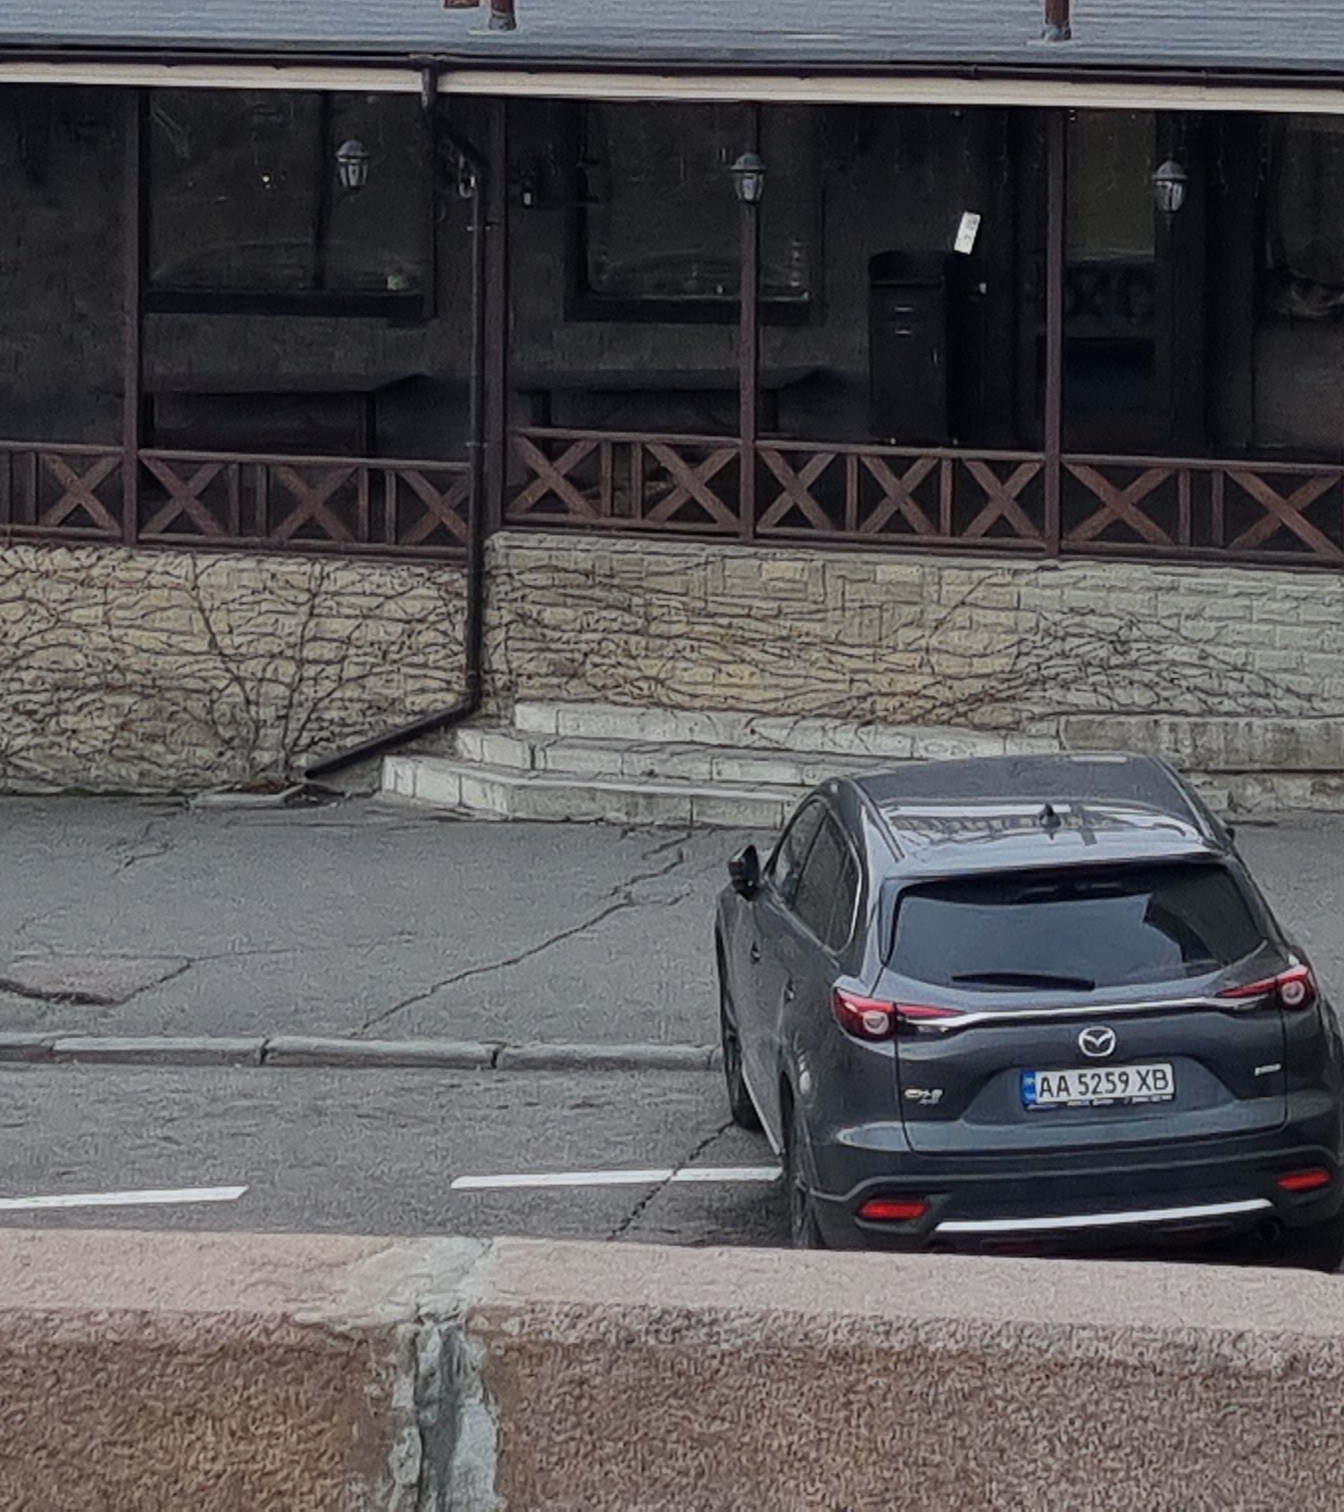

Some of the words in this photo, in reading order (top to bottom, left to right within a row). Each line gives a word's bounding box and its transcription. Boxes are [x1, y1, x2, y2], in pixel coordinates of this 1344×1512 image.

[1039, 1075, 1071, 1098] AA
[1077, 1071, 1130, 1096] 5259
[1136, 1068, 1169, 1093] XB
